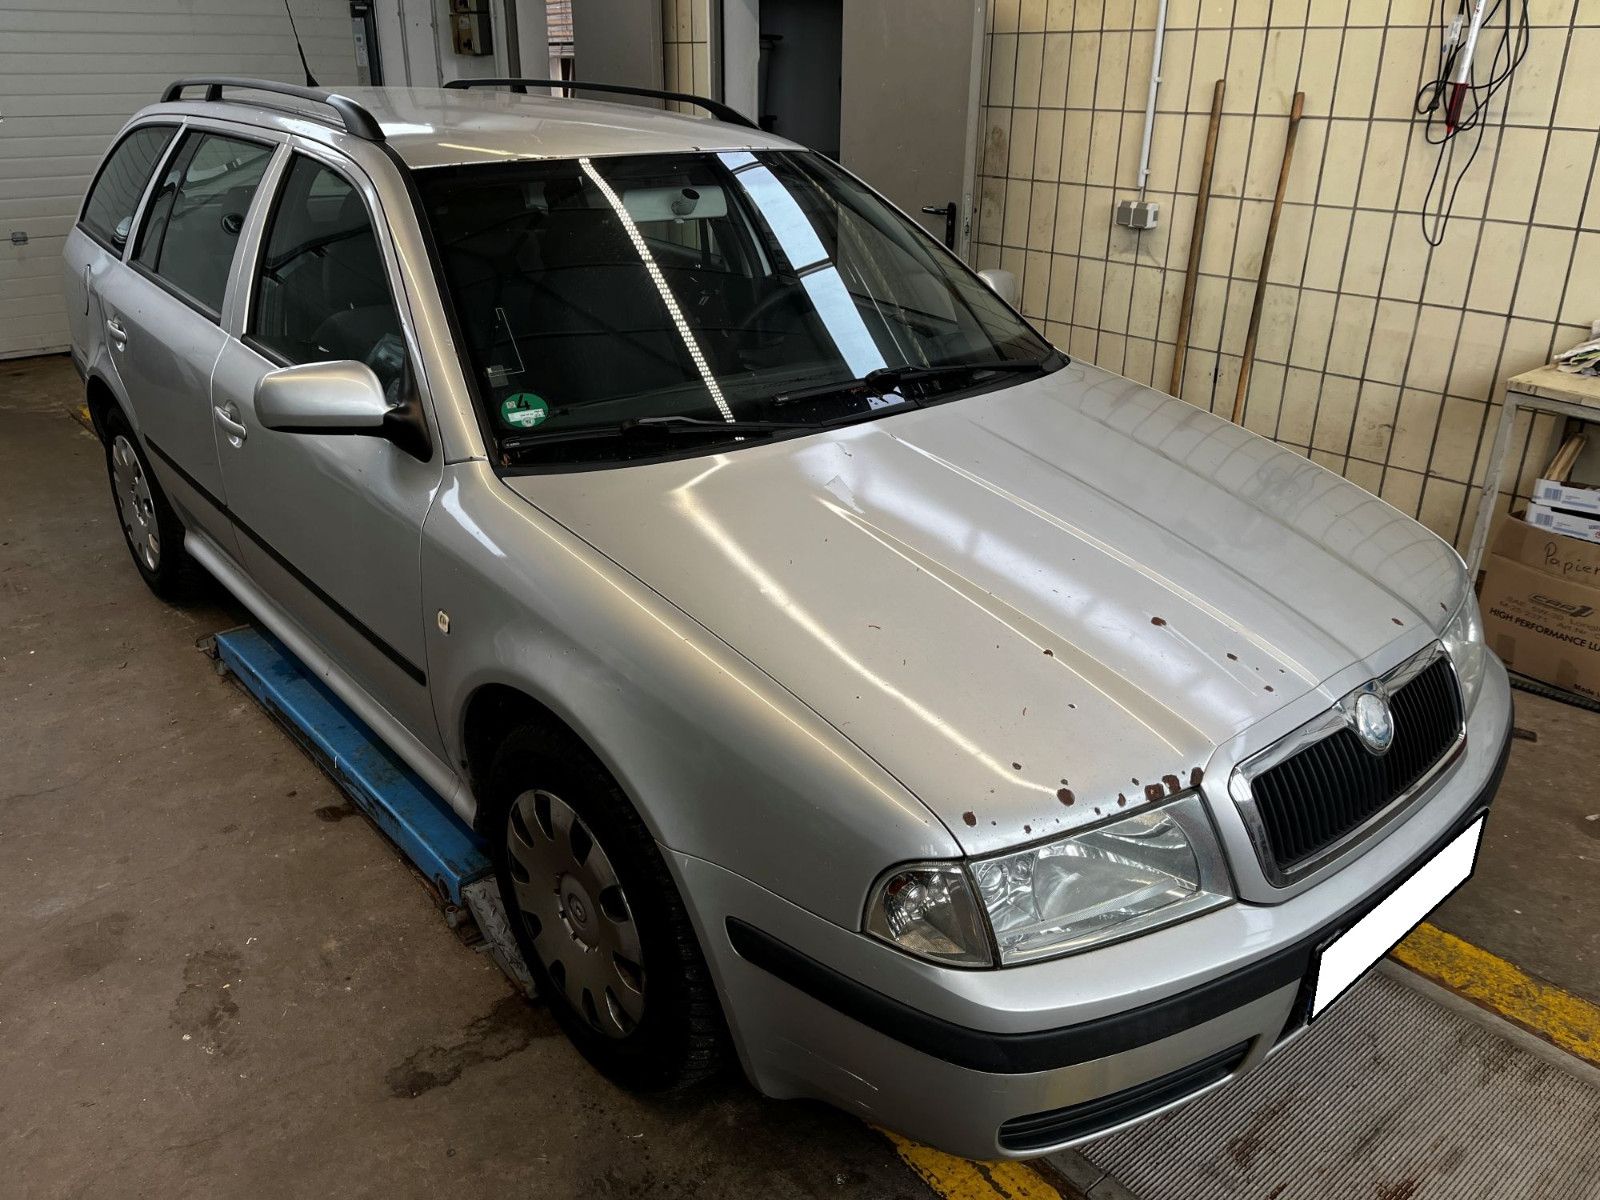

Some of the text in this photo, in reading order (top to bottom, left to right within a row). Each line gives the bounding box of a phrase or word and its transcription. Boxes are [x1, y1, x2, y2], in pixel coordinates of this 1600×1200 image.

[516, 393, 531, 410] 4
[1543, 541, 1600, 575] Papier
[1489, 607, 1513, 622] HIGH
[1514, 617, 1587, 647] PERFORMANCE
